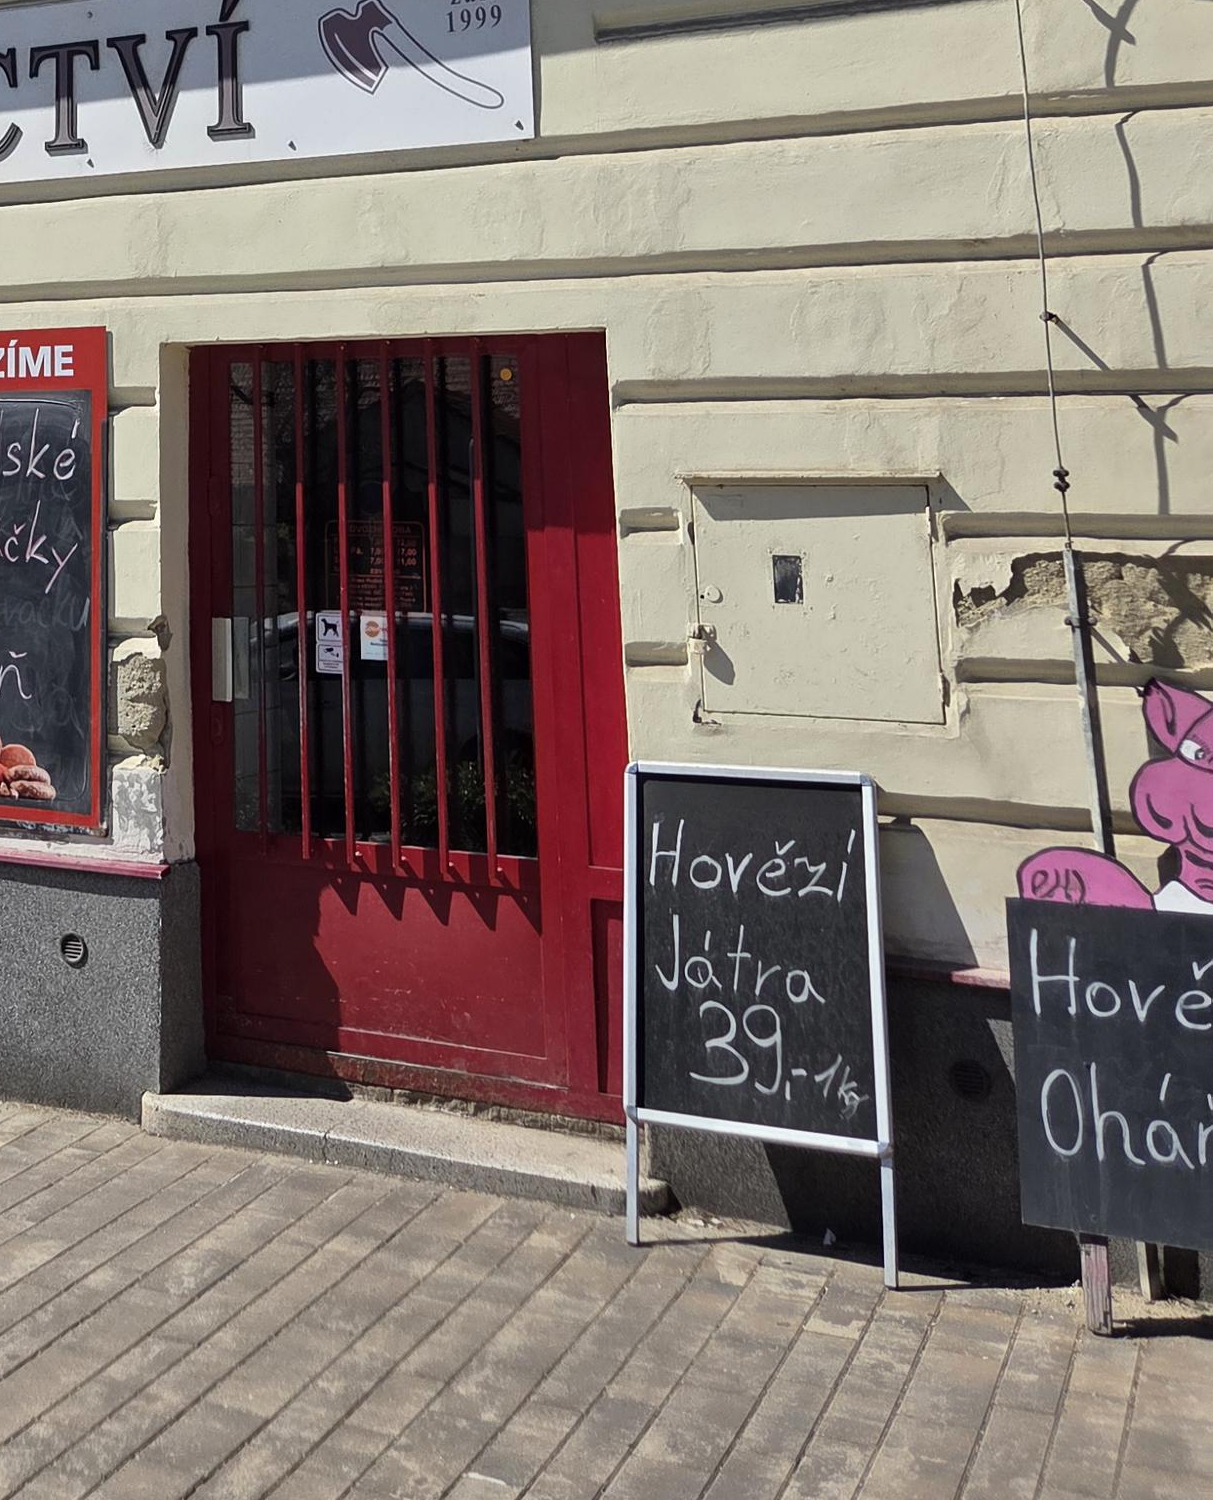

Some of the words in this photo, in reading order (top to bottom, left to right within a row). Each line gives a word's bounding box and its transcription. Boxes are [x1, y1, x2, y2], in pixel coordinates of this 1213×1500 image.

[445, 5, 504, 34] 1999
[649, 818, 856, 903] Hovězí
[655, 913, 826, 1005] Játra
[1029, 928, 1213, 1030] Hově
